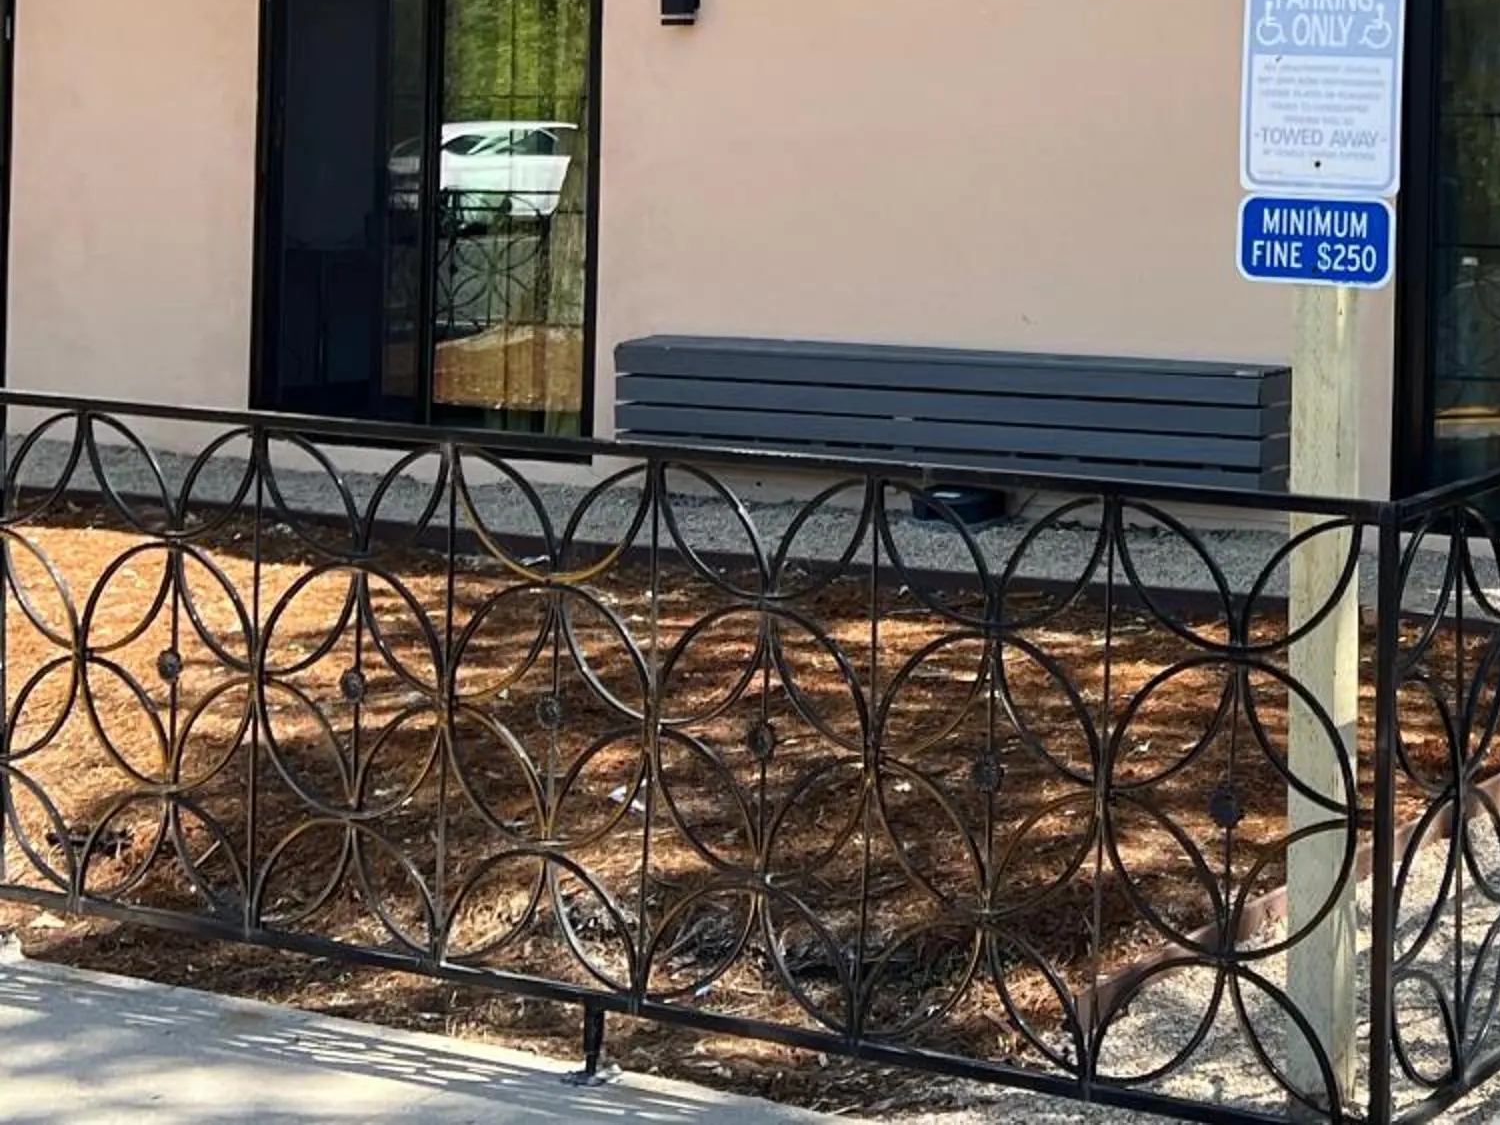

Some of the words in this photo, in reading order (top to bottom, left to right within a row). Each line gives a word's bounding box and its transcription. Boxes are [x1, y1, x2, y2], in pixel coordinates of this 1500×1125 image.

[1292, 13, 1353, 47] ONLY
[1263, 207, 1368, 239] MINIMUM
[1252, 240, 1303, 268] FINE
[1317, 241, 1377, 273] $250
